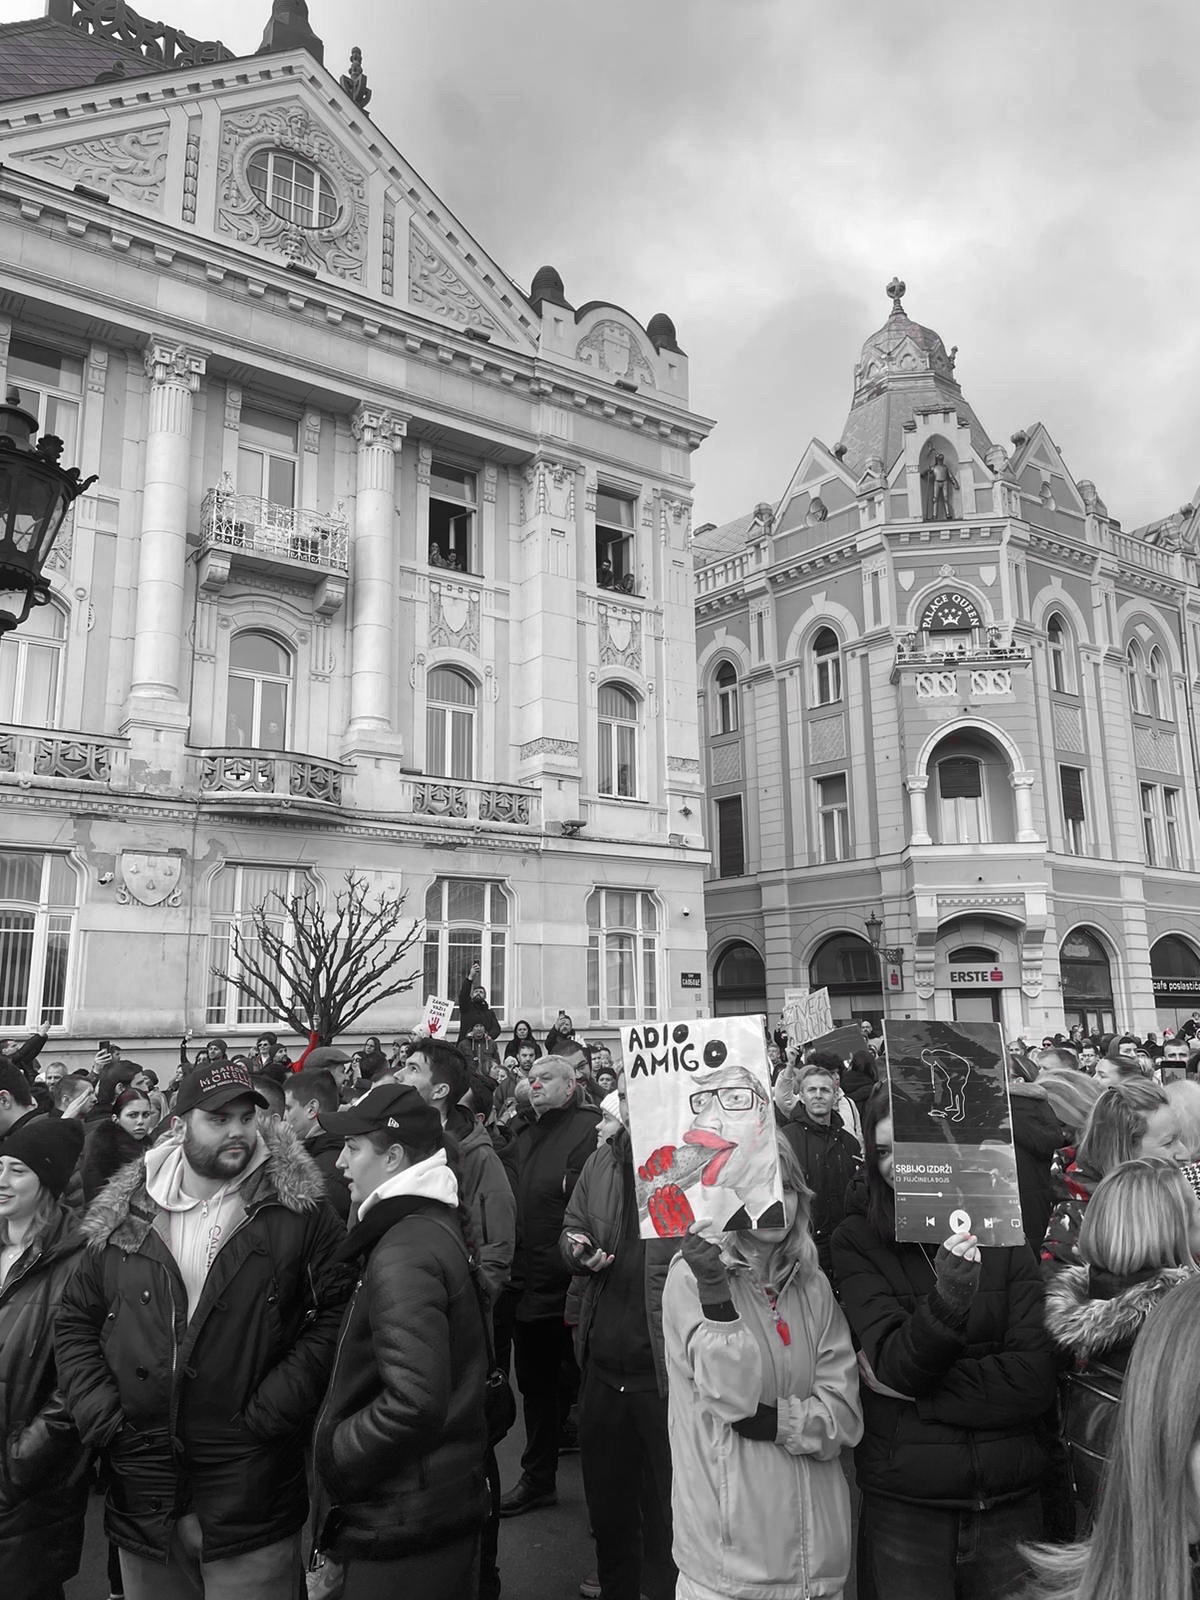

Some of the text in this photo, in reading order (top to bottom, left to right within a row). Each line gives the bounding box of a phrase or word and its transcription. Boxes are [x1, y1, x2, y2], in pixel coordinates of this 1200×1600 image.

[922, 594, 980, 627] PALACE QUEEN
[950, 970, 989, 982] ERSTE
[1152, 980, 1168, 990] cafe
[629, 1023, 689, 1052] ADIO
[631, 1039, 728, 1078] AMIGO
[895, 1163, 952, 1174] SRBIJO IZDRŽI
